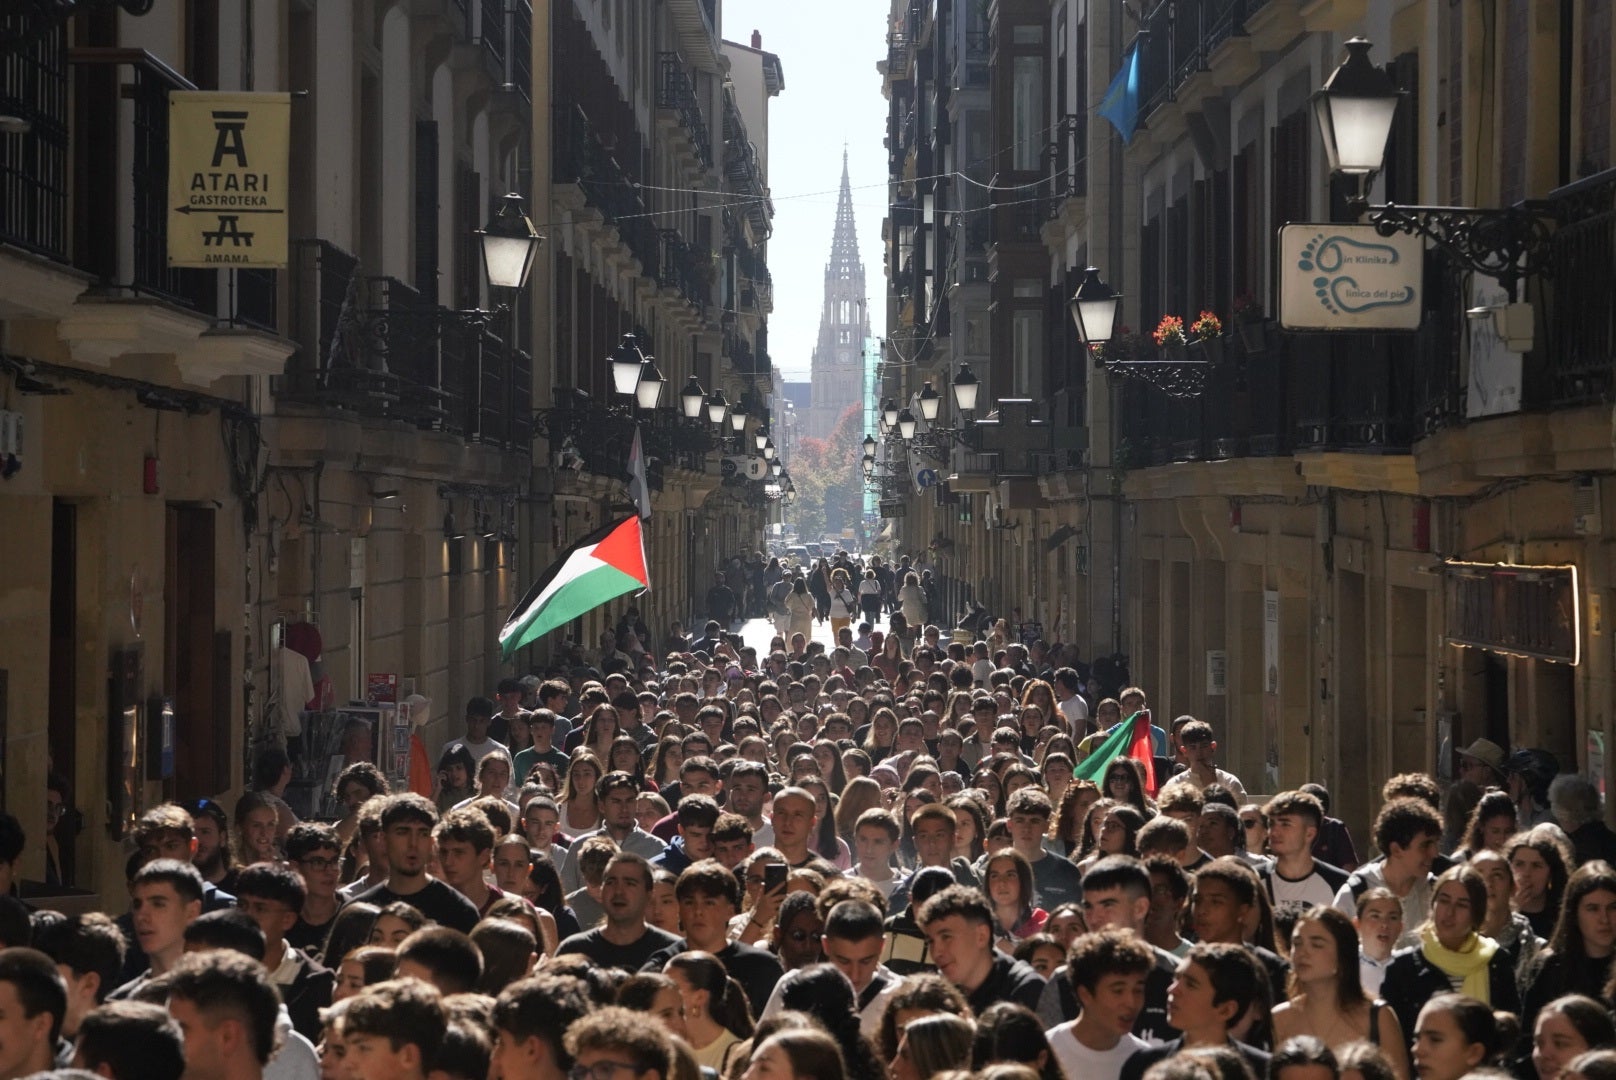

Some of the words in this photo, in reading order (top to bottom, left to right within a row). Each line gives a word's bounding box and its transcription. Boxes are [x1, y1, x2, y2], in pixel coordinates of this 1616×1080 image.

[190, 173, 268, 192] ATARI
[190, 195, 267, 206] GASTROTEKA
[205, 254, 249, 263] AMAMA
[1355, 255, 1388, 264] Klinika
[1373, 289, 1388, 298] del
[1390, 289, 1406, 300] pie
